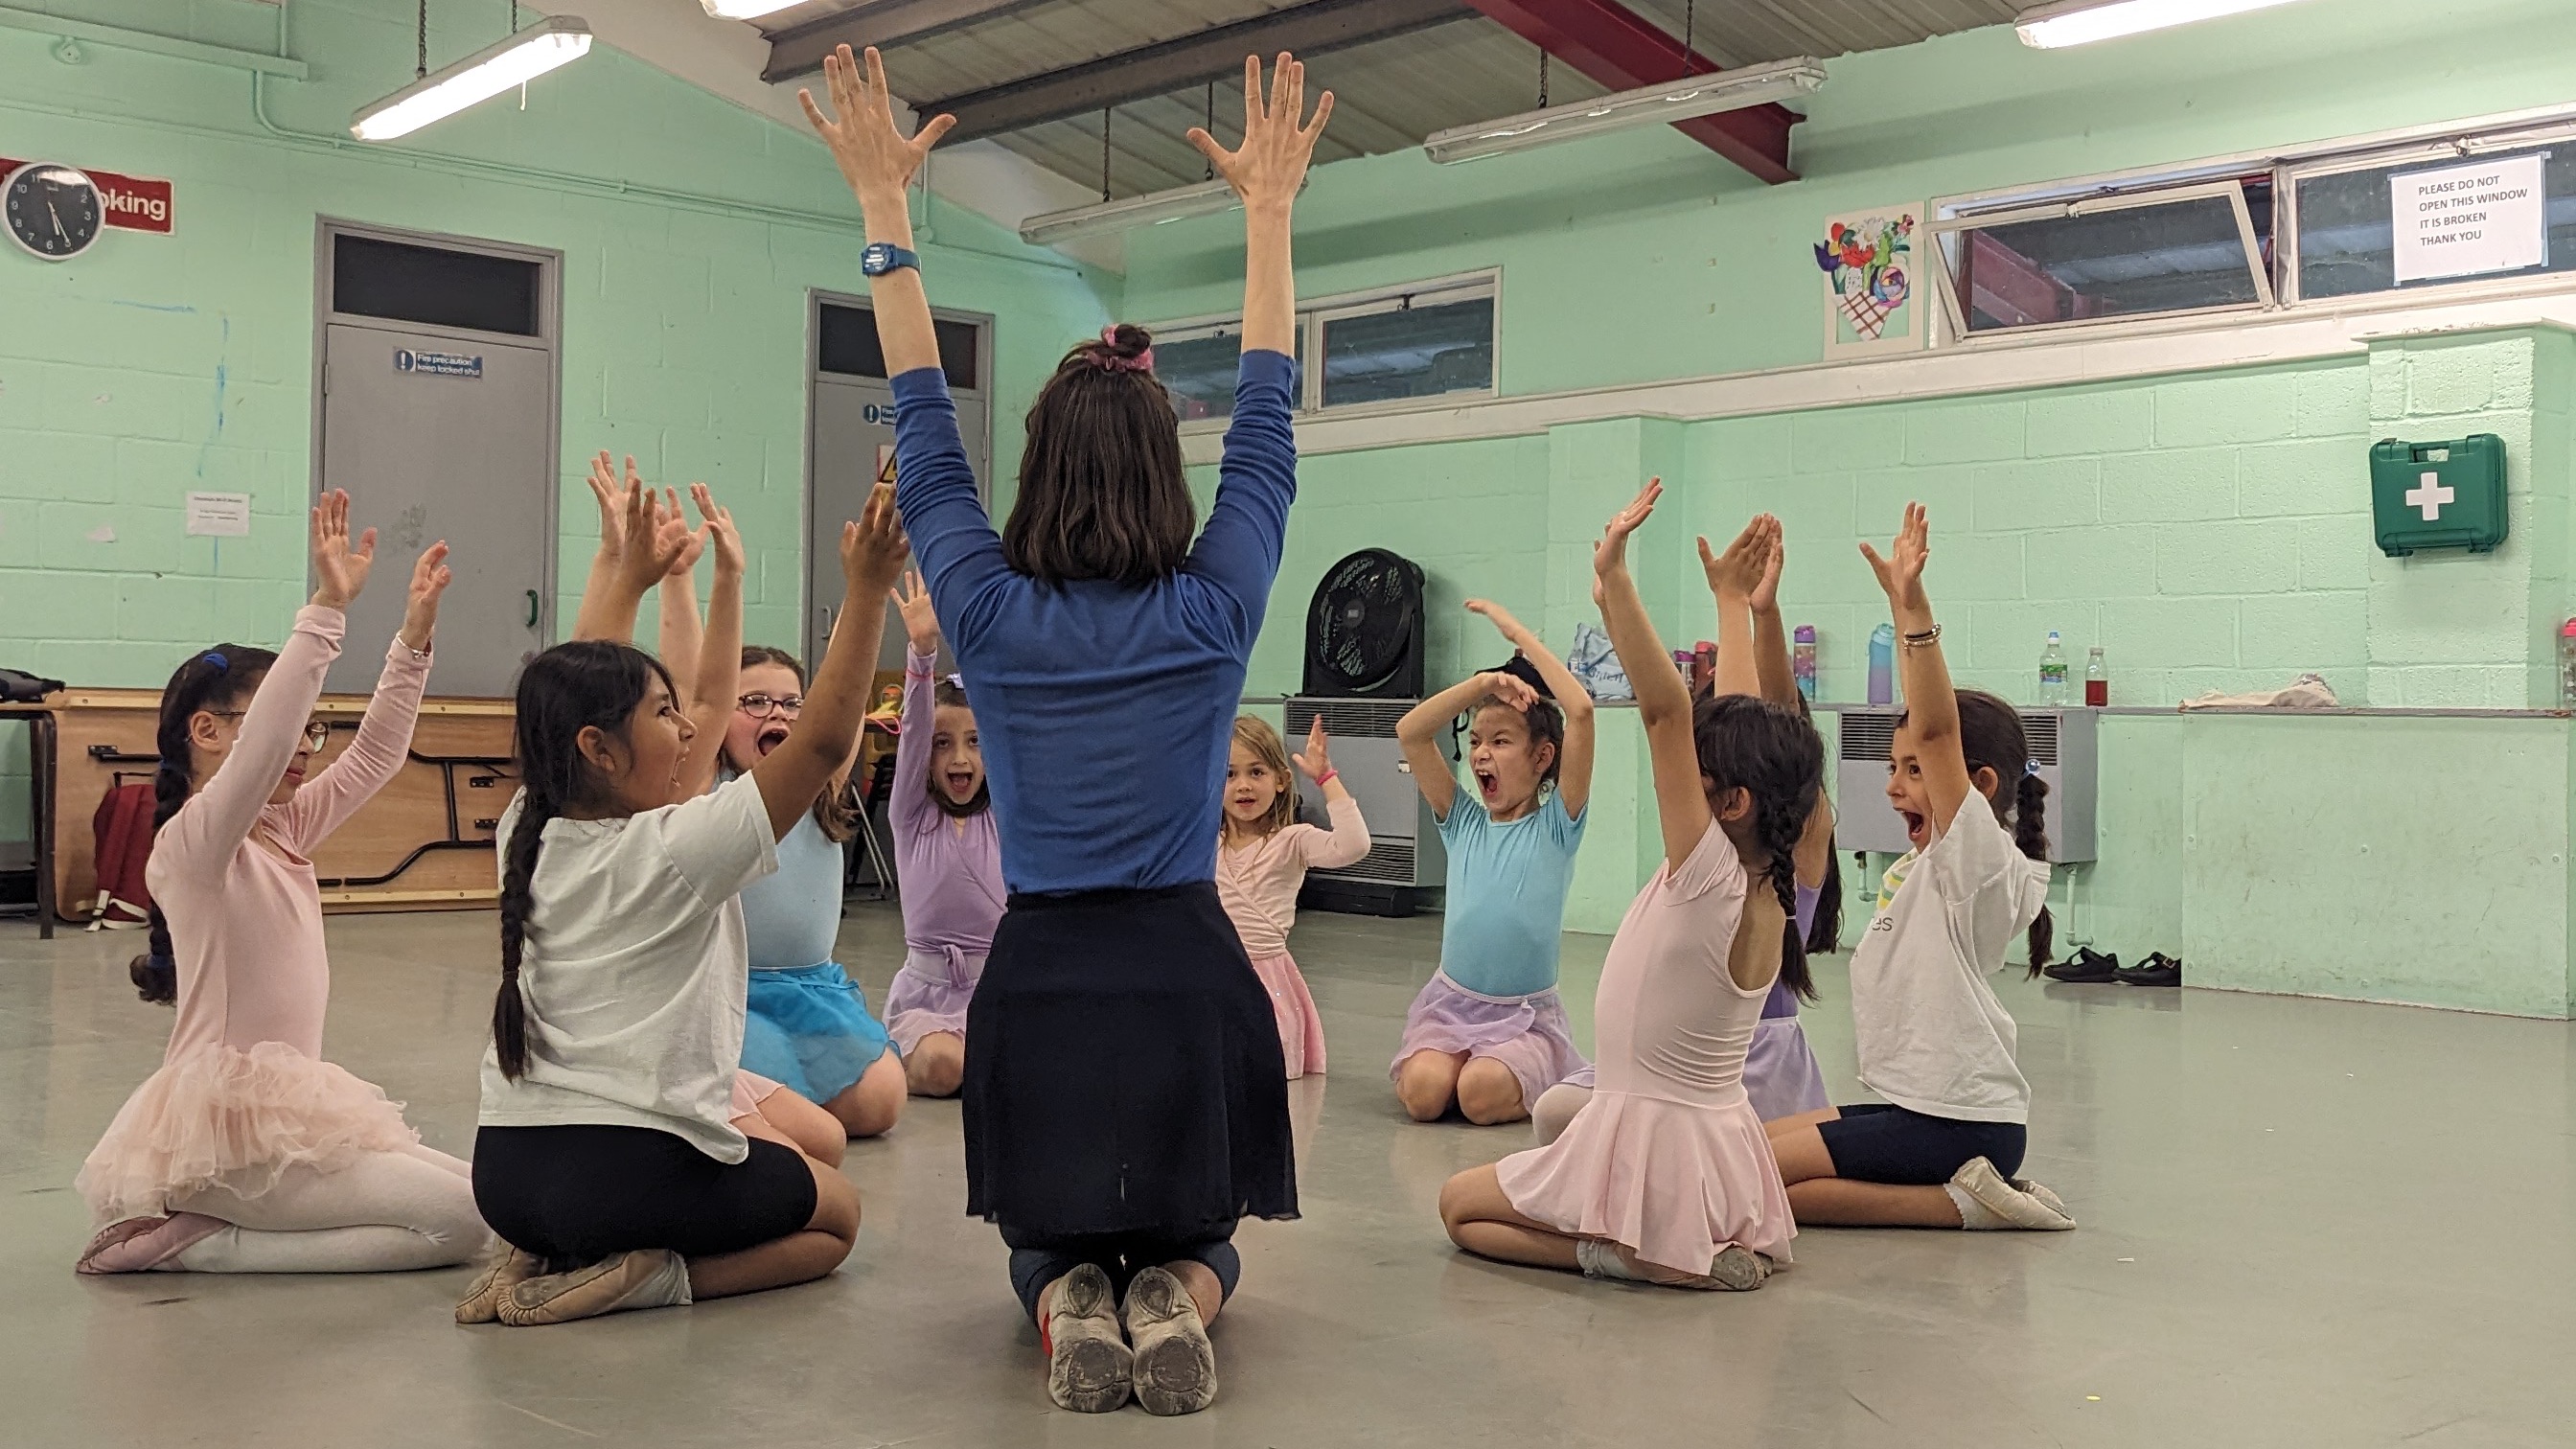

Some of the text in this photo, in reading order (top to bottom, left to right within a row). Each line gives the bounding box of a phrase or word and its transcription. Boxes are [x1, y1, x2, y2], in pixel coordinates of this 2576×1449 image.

[17, 183, 28, 194] 10
[2419, 175, 2500, 196] PLEASE DO NOT
[80, 195, 88, 204] 2
[2419, 189, 2528, 212] OPEN THIS WINDOW
[12, 200, 19, 210] 9
[84, 211, 92, 220] 3
[2420, 212, 2487, 229] IT IS BROKEN
[15, 218, 23, 228] 8
[28, 232, 35, 242] 7
[79, 228, 85, 237] 4
[2420, 229, 2482, 246] THANK YOU
[46, 240, 54, 250] 6
